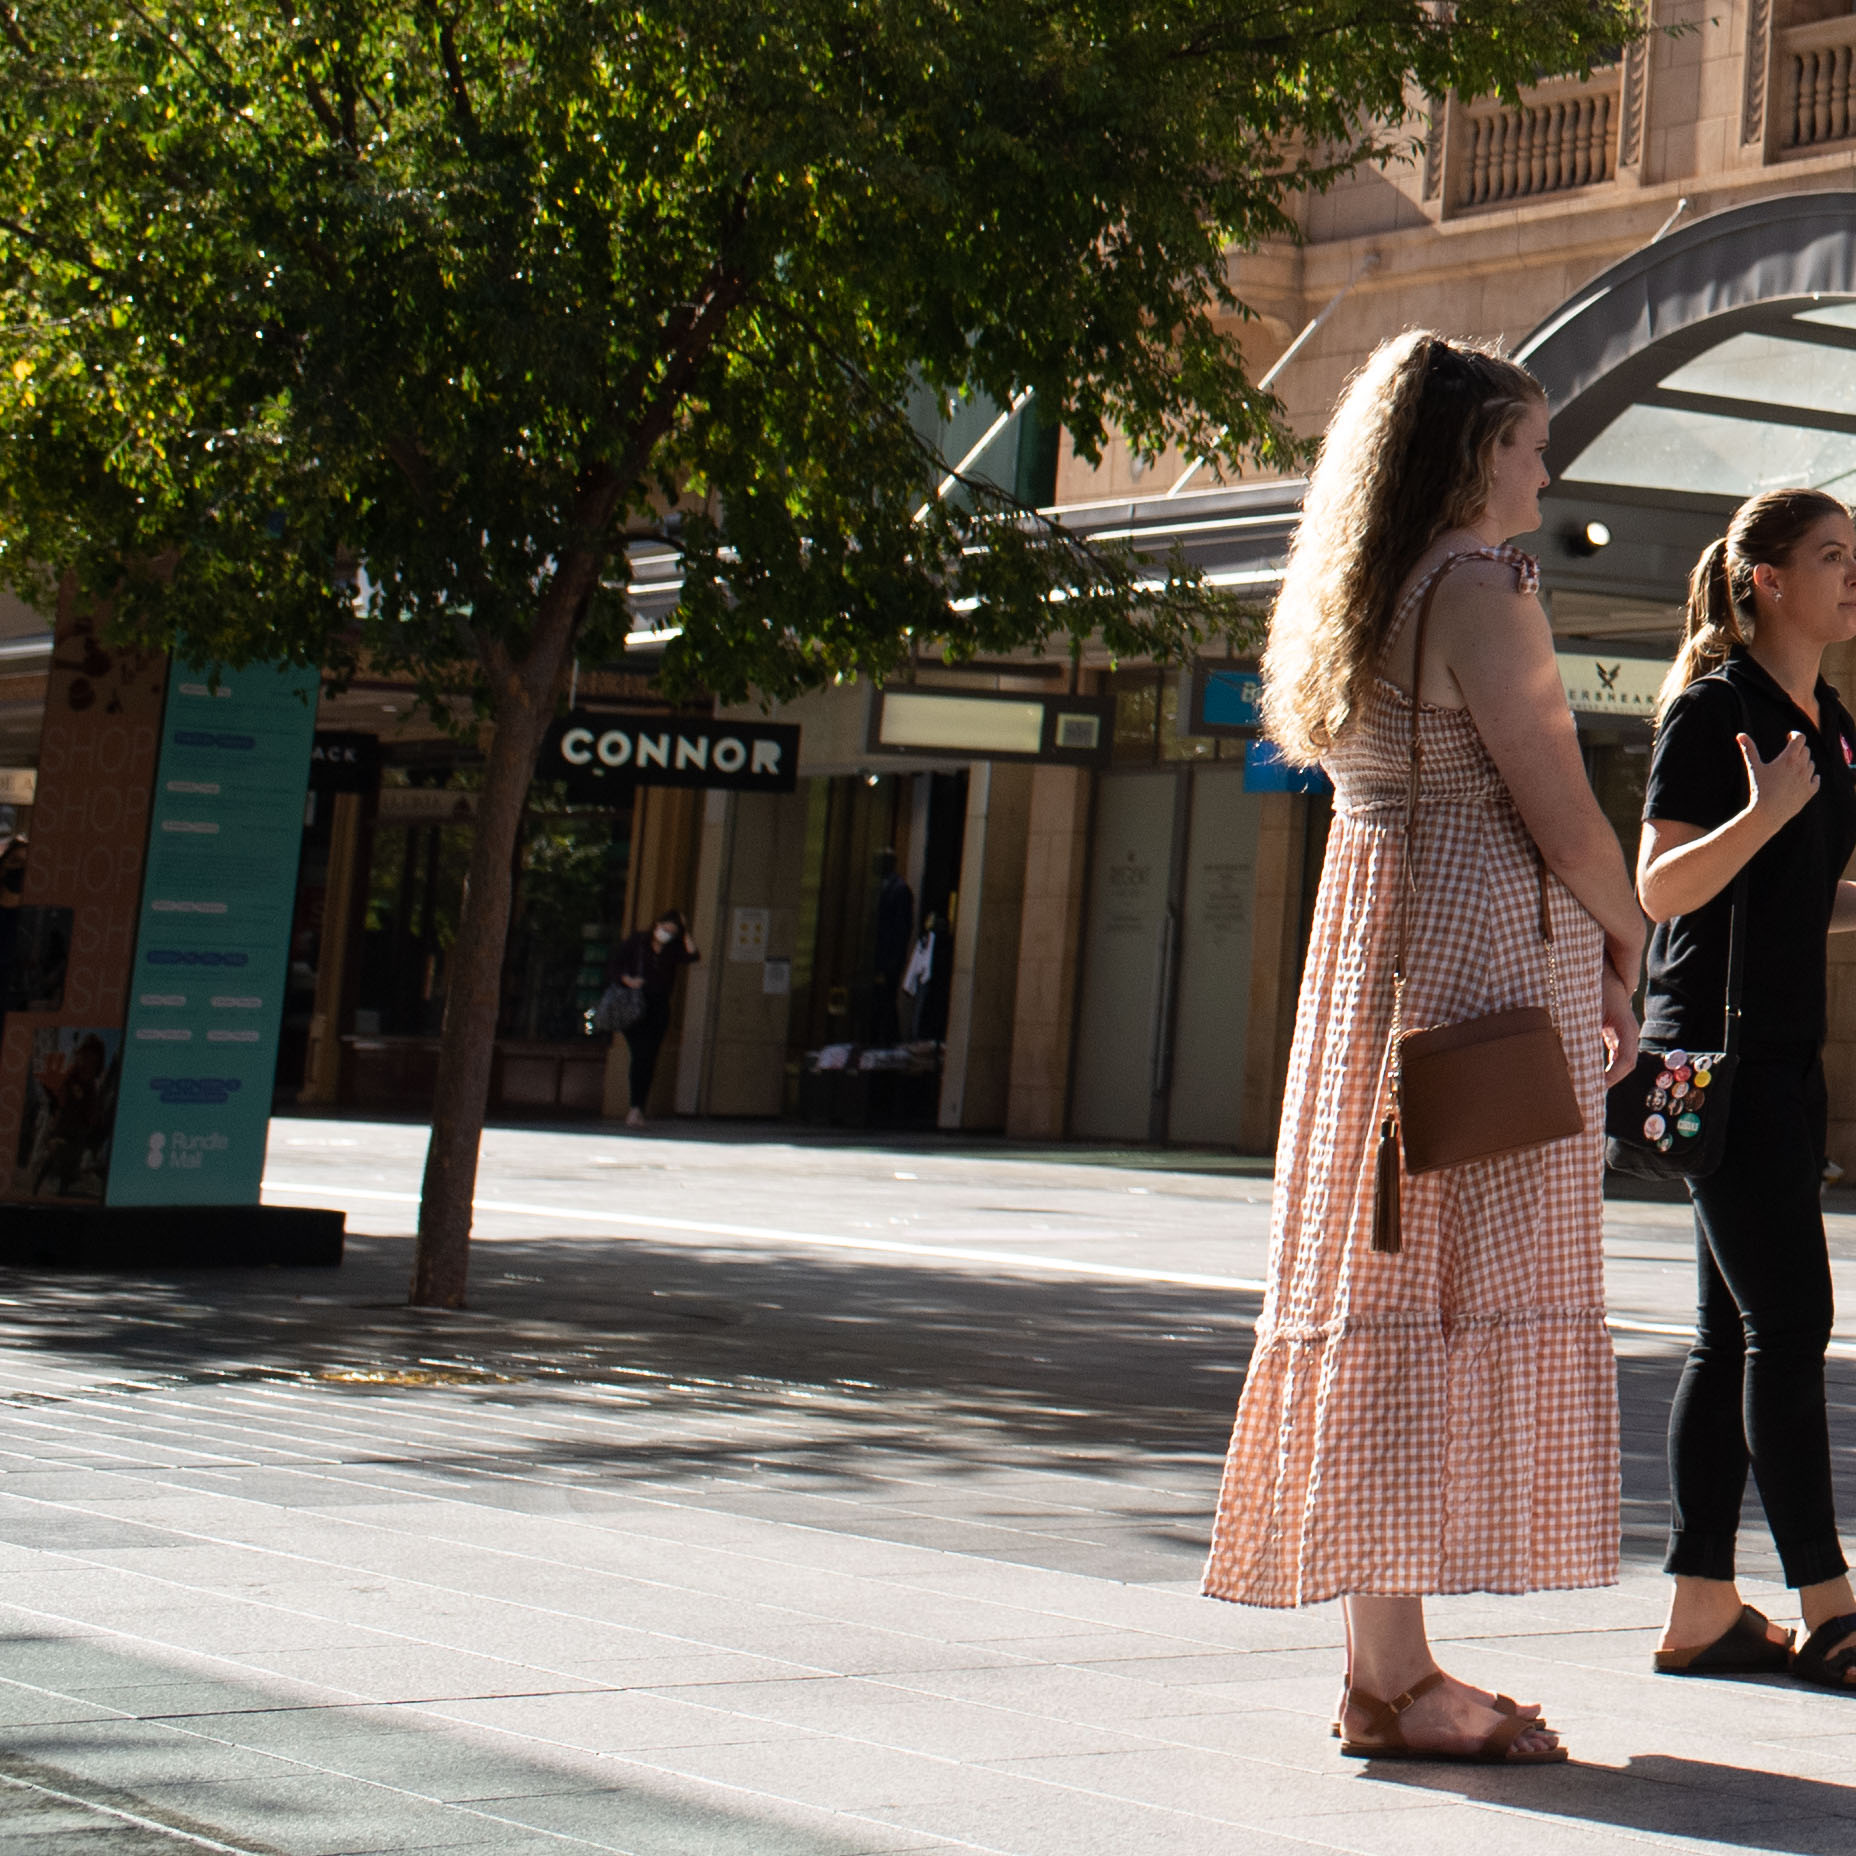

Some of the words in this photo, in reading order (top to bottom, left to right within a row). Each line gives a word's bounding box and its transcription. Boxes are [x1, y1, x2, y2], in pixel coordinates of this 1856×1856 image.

[43, 726, 155, 773] SHOP
[312, 745, 359, 765] ACK
[559, 726, 783, 776] CONNOR
[34, 785, 148, 834] SHOP
[26, 845, 142, 895] SHOP
